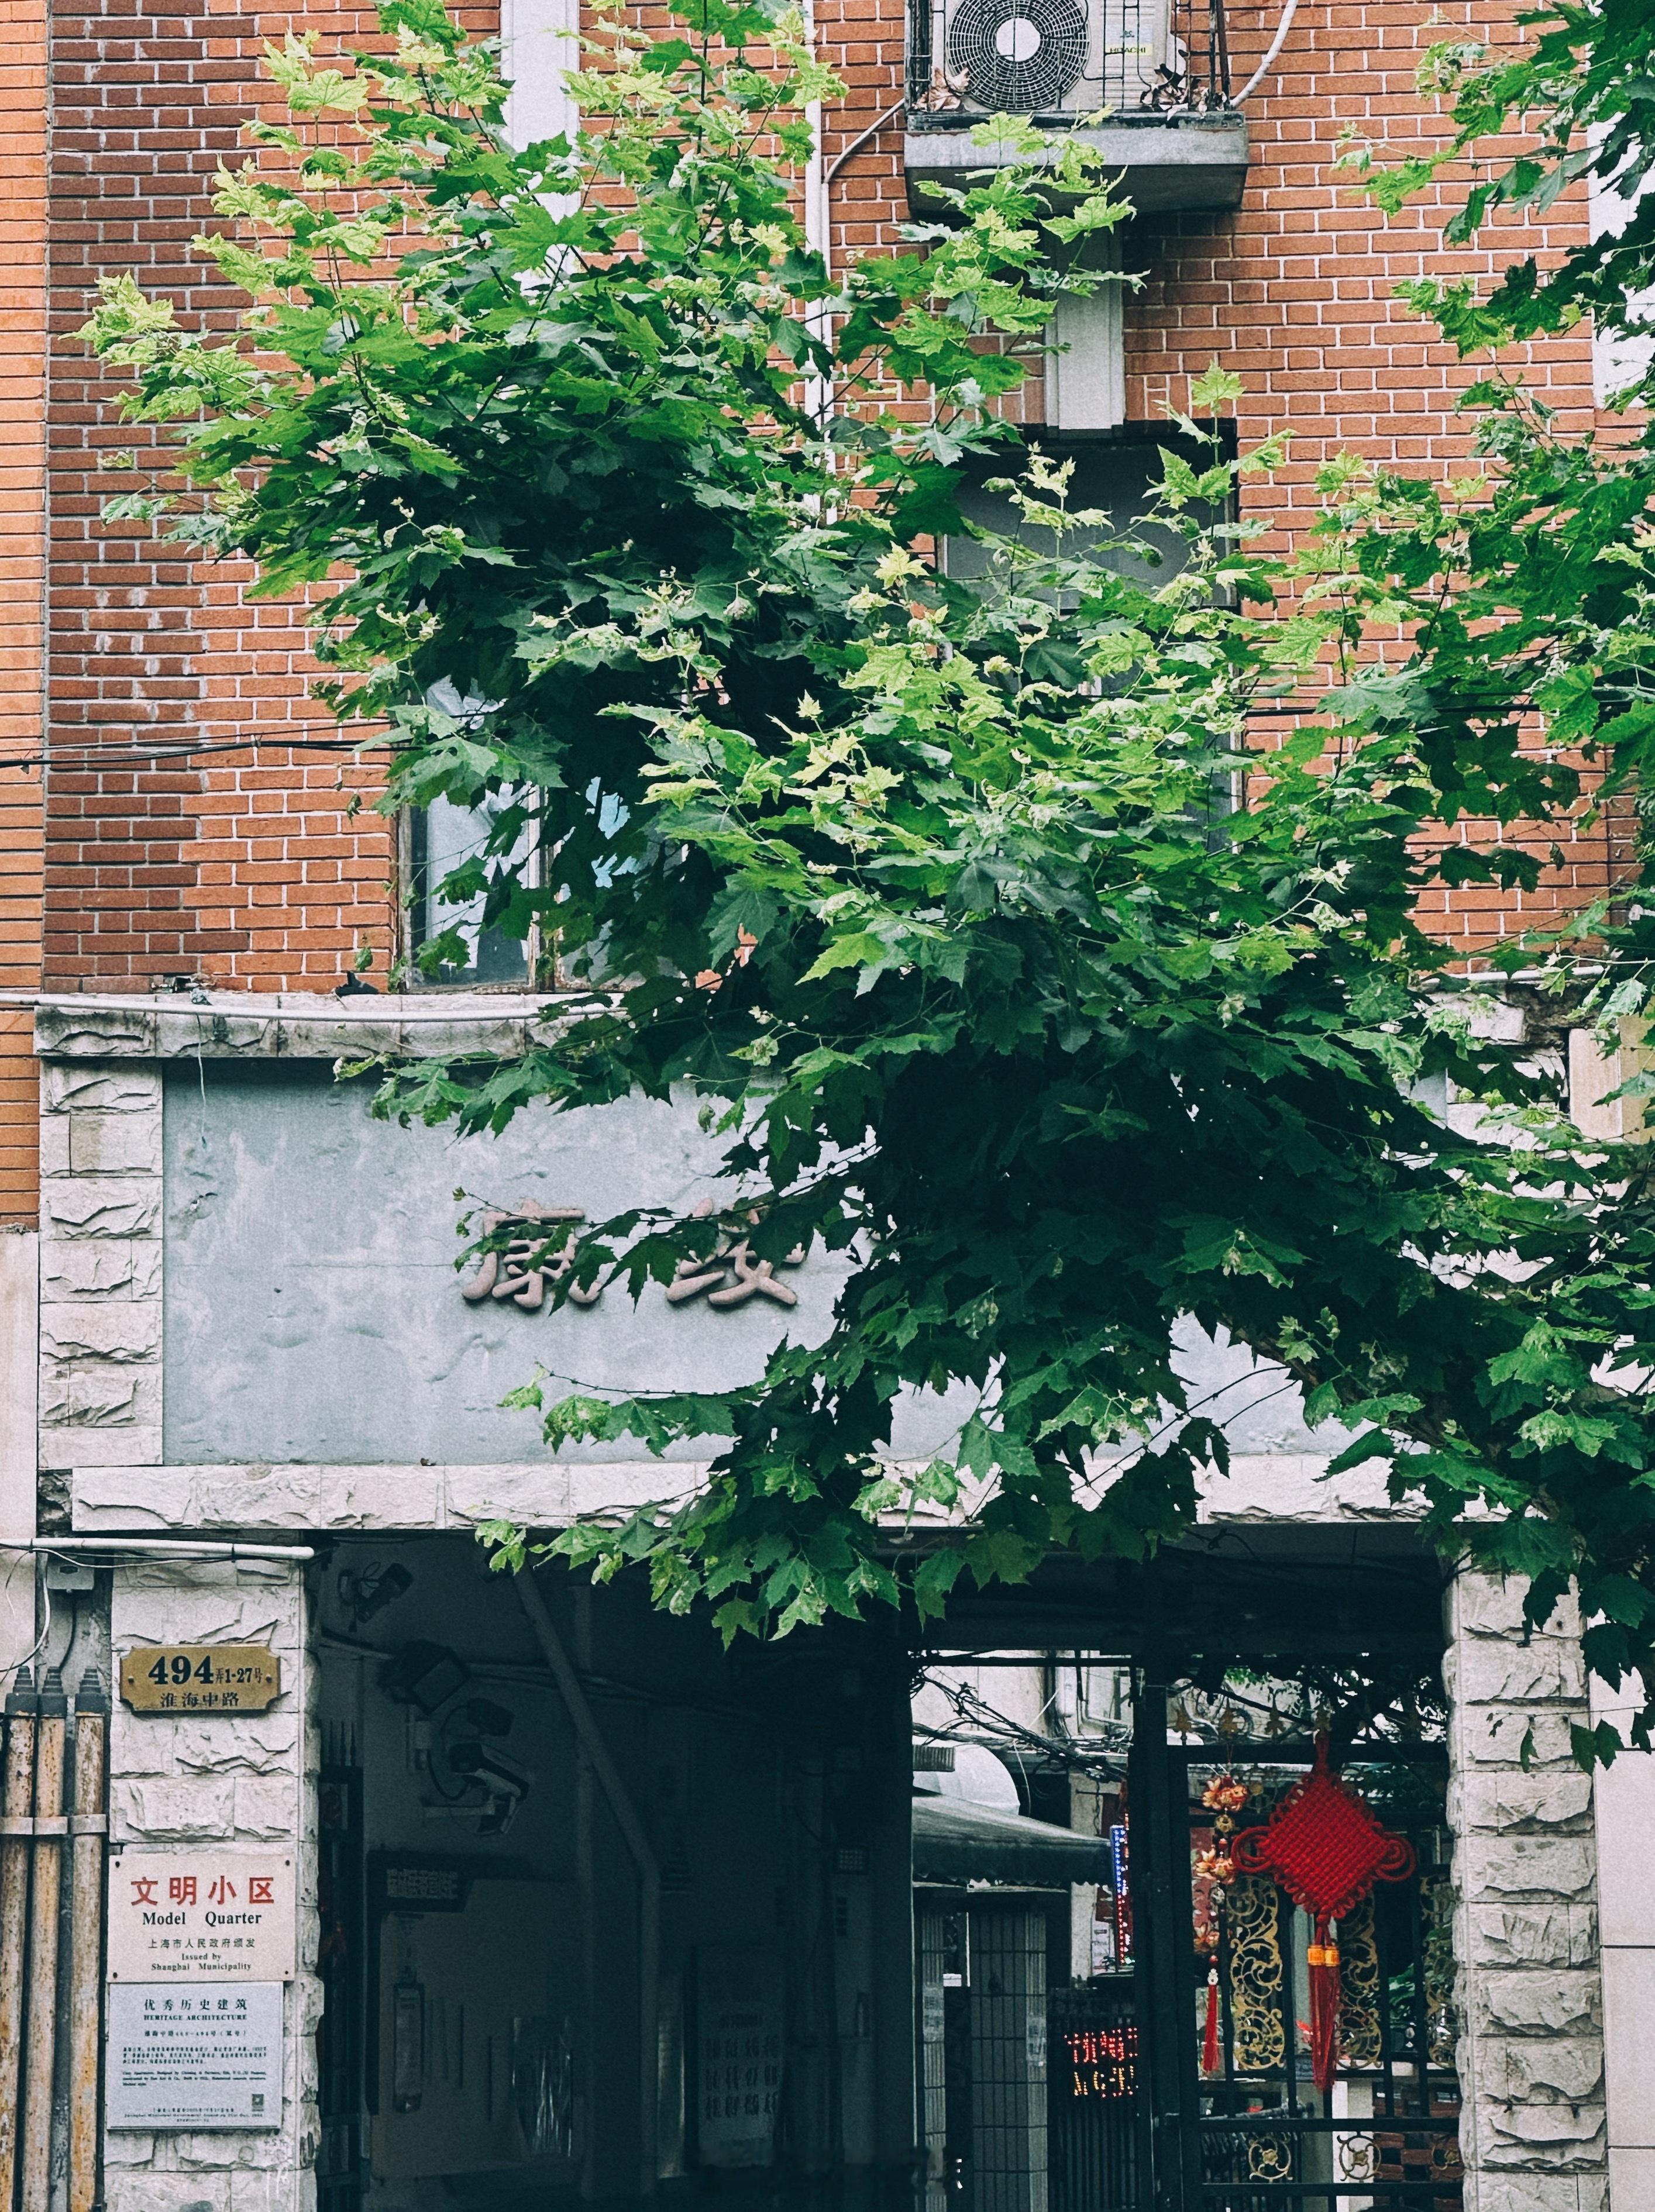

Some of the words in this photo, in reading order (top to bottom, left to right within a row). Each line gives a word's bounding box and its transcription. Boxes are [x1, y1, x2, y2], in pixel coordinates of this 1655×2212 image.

[160, 1692, 239, 1707] 淮海中路
[130, 1875, 274, 1906] 文明小区
[142, 1912, 186, 1925] Model
[205, 1911, 262, 1927] Quarter
[148, 1938, 256, 1949] 上海市人民政府颁发
[212, 1953, 222, 1962] by
[151, 1963, 190, 1972] Shanghai
[198, 1963, 252, 1971] Municipality
[144, 1999, 247, 2011] 优秀历史建筑
